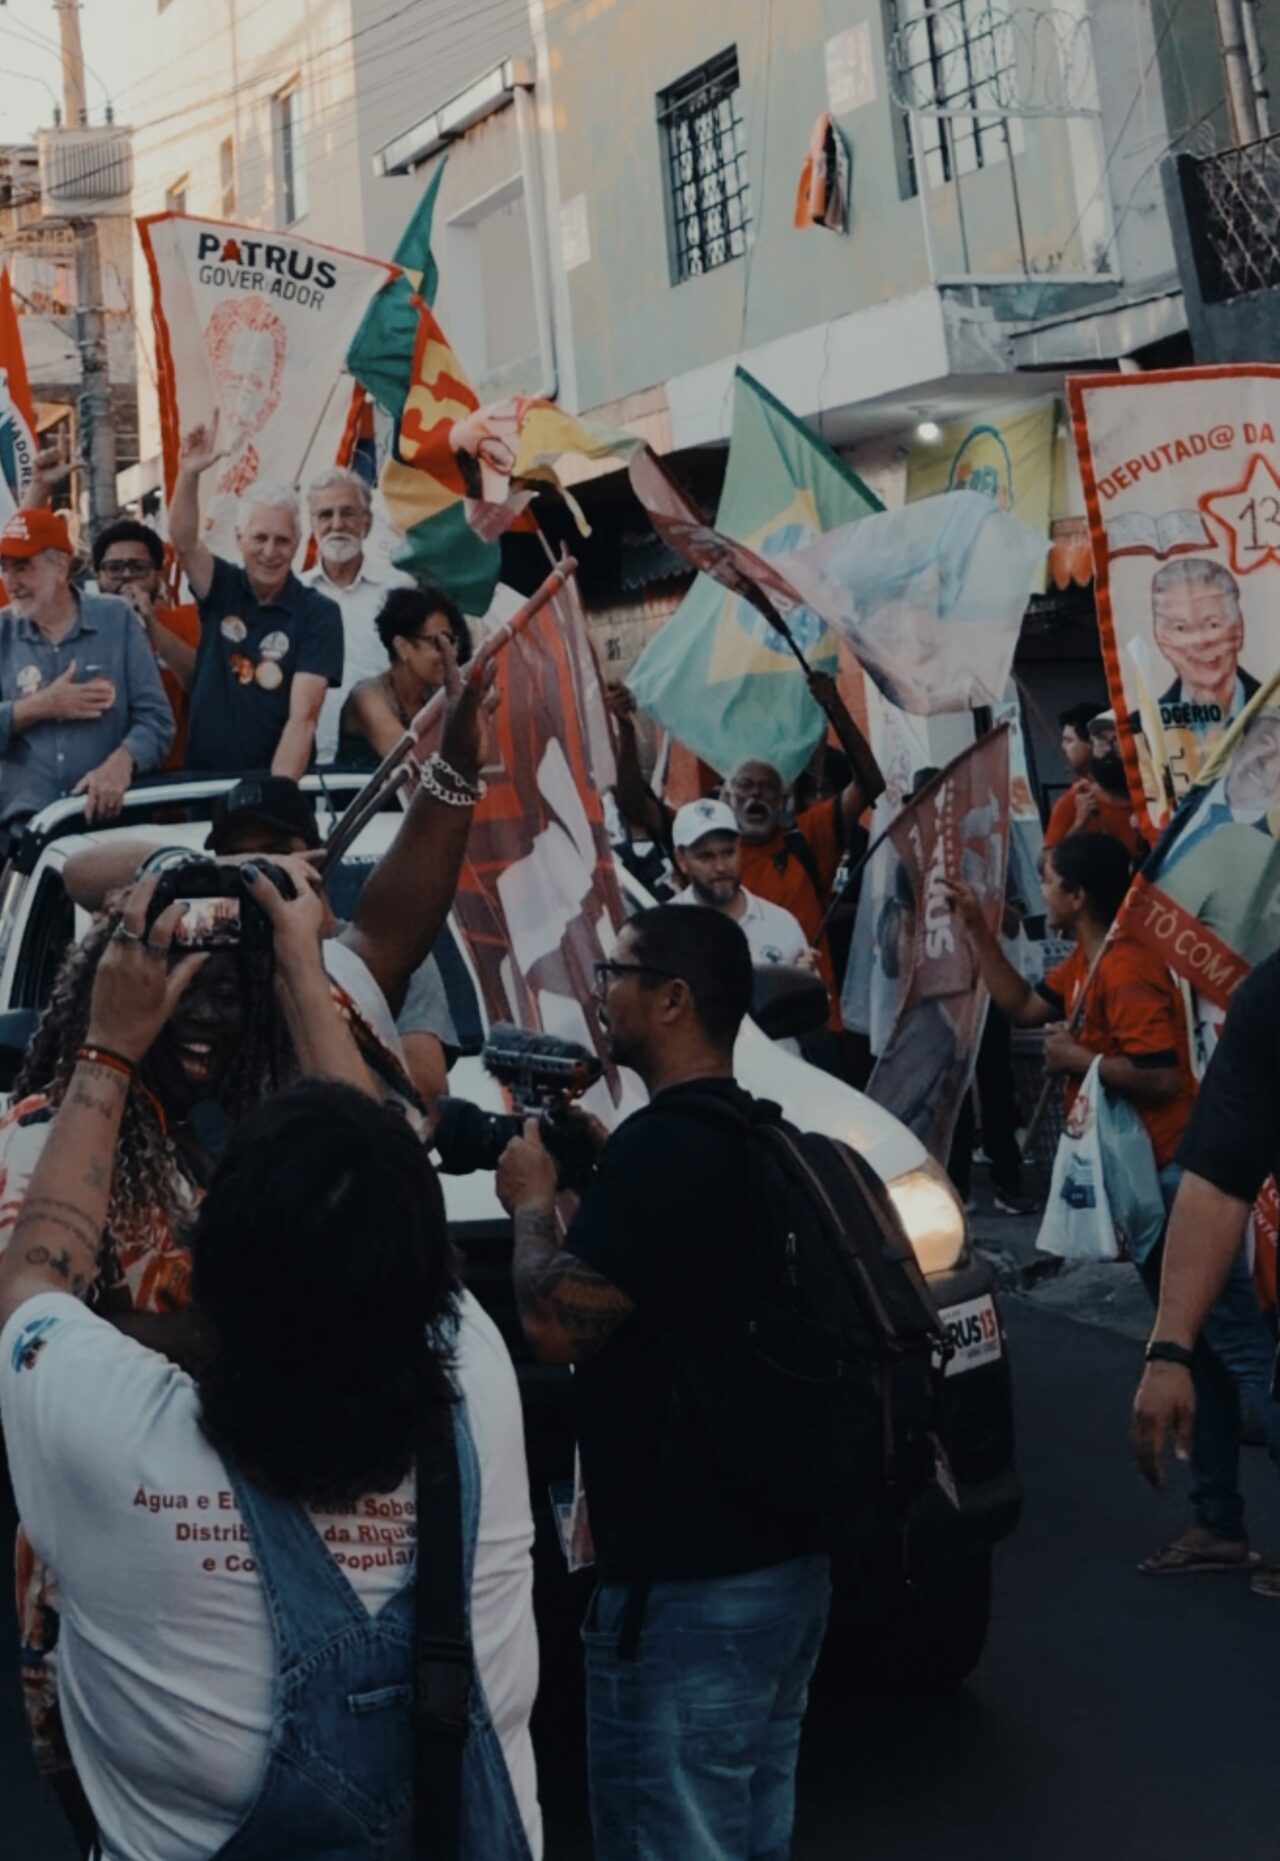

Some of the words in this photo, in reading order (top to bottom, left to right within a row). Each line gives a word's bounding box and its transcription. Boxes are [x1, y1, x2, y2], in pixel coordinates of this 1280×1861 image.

[198, 232, 336, 289] PATRUS
[199, 265, 325, 310] GOVERADOR
[1096, 424, 1234, 500] DEPUTAD@
[1243, 422, 1275, 445] DA
[1159, 702, 1222, 725] OGÉRIO
[1175, 929, 1235, 986] COM
[133, 1484, 188, 1513] Água
[197, 1495, 209, 1509] e
[364, 1498, 416, 1517] Sobe
[176, 1523, 250, 1541] Distrib
[324, 1525, 350, 1541] da
[358, 1525, 417, 1545] Rique
[203, 1557, 216, 1572] e
